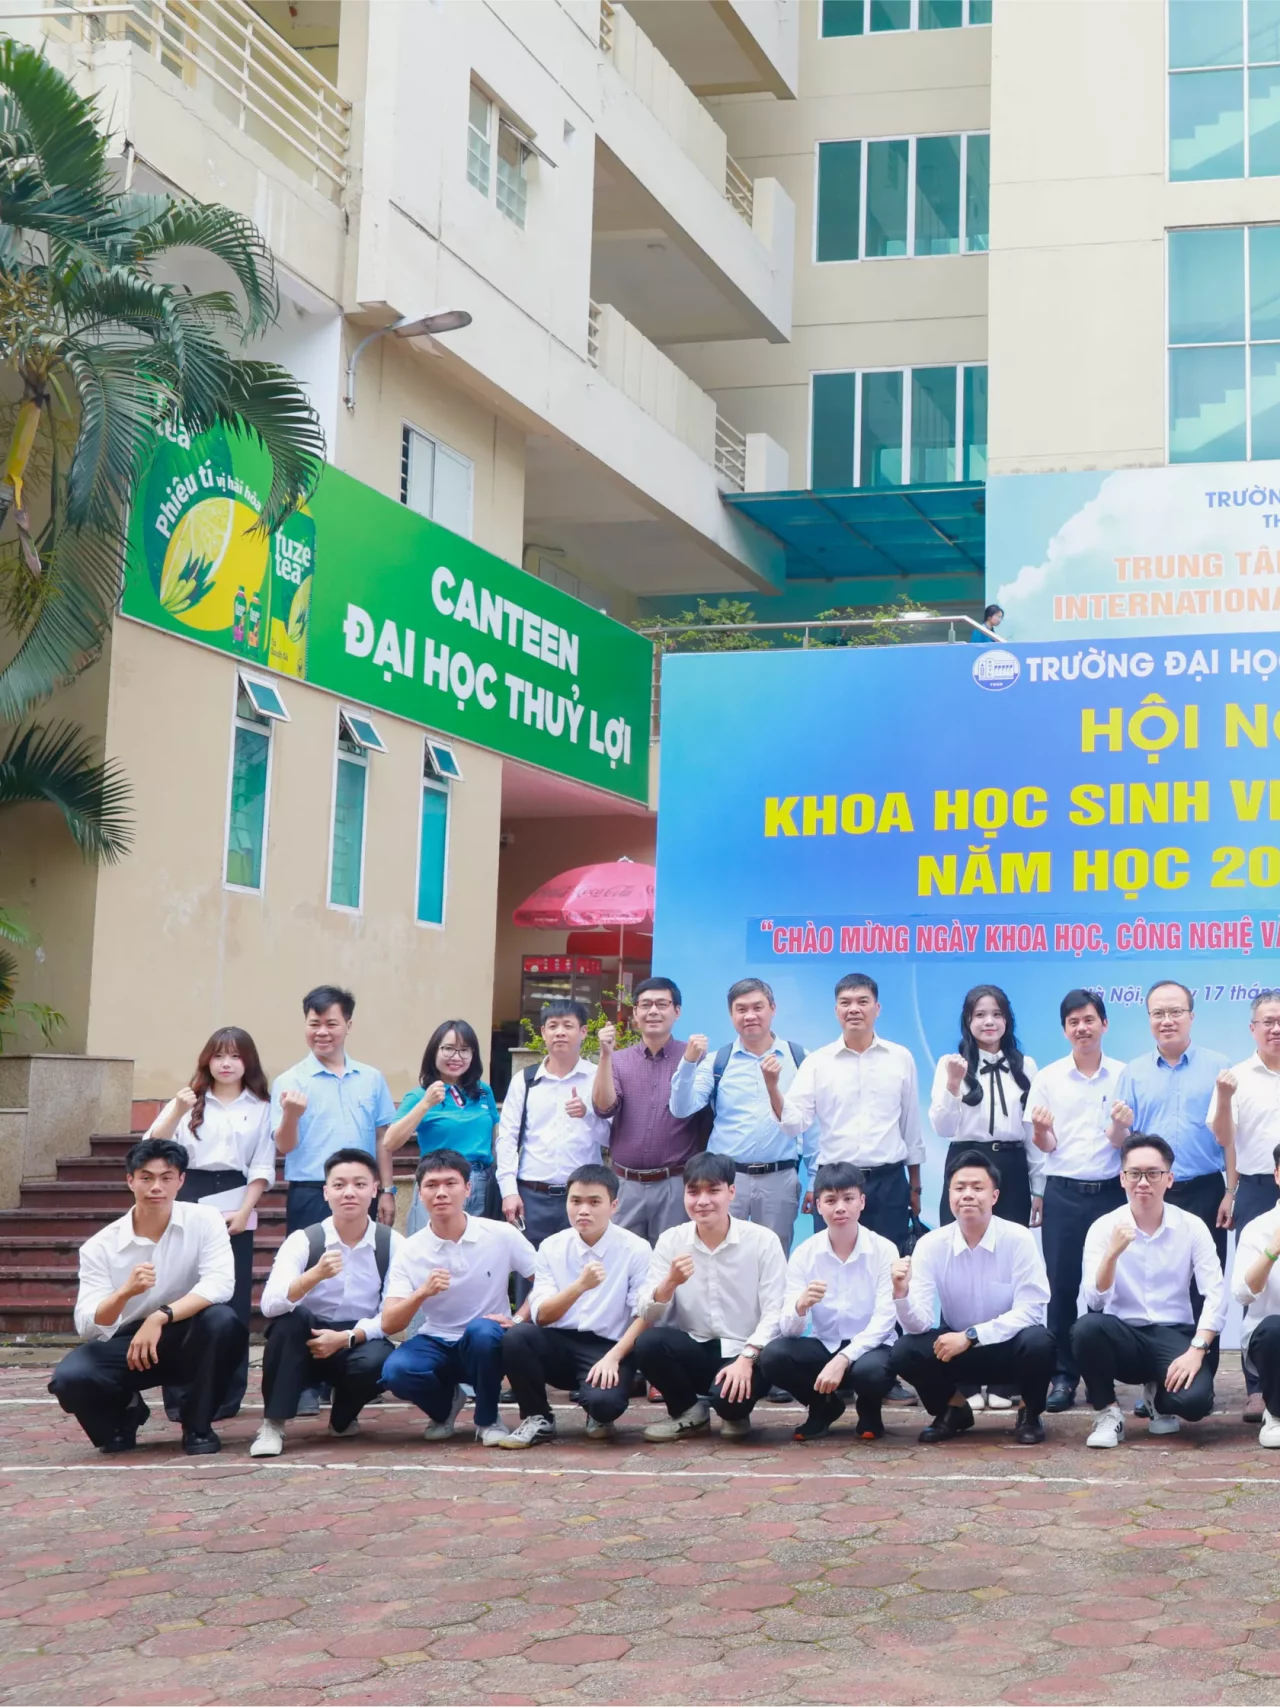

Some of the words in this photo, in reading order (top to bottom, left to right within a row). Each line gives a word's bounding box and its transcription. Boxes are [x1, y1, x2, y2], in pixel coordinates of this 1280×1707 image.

[155, 473, 198, 539] Phiêu
[198, 459, 214, 488] tí
[216, 473, 226, 492] vị
[227, 476, 243, 494] hài
[275, 525, 312, 568] fuze
[275, 552, 302, 586] tea
[1114, 552, 1223, 582] TRUNG
[431, 566, 579, 676] CANTEEN
[343, 602, 415, 682] ĐẠI
[424, 641, 497, 711] HỌC
[504, 671, 583, 744] THUỶ
[589, 714, 632, 771] LỢI
[1026, 649, 1155, 683] TRƯỜNG
[1164, 649, 1218, 683] ĐẠI
[1080, 693, 1199, 764] HỘI
[764, 791, 914, 837] KHOA
[933, 787, 1048, 839] HỌC
[1069, 780, 1210, 826] SINH
[917, 844, 1051, 897] NĂM
[1073, 847, 1190, 899] HỌC
[840, 920, 909, 953] MỪNG
[916, 919, 978, 953] NGÀY
[985, 923, 1047, 952] KHOA
[1055, 923, 1109, 958] HỌC,
[1116, 916, 1182, 951] CÔNG
[1189, 915, 1253, 955] NGHỆ
[1110, 985, 1144, 1006] Nội,
[1205, 985, 1225, 1000] 17
